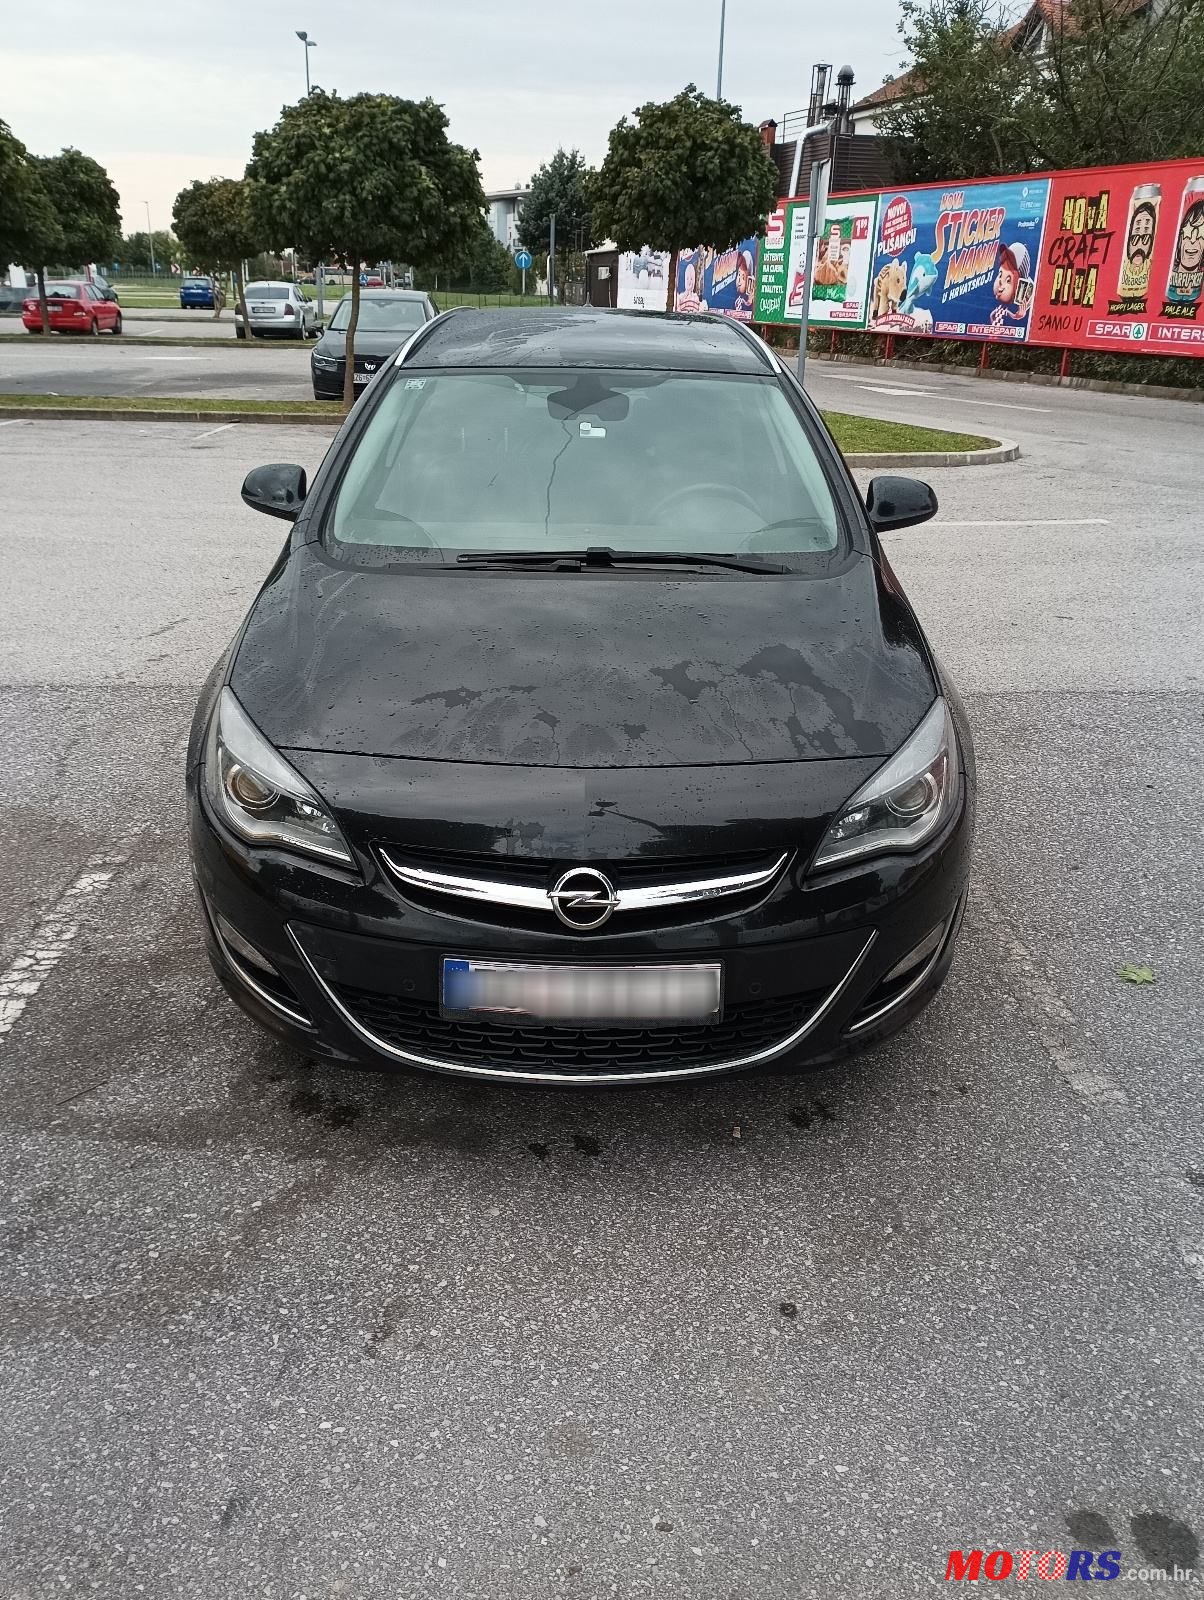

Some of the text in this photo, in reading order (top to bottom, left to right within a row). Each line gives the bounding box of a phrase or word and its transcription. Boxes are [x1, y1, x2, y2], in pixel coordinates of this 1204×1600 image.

[940, 191, 964, 211] NOVA
[1062, 193, 1108, 234] NOVA
[930, 207, 1006, 260] STICKER
[1048, 231, 1116, 266] CRAFT
[1051, 267, 1097, 305] PIVA
[1127, 303, 1144, 311] LAGER
[1165, 306, 1195, 316] PALE ALE
[971, 326, 1016, 335] INTERSPAR
[1038, 315, 1083, 332] SAMO U
[1095, 324, 1131, 336] SPAR
